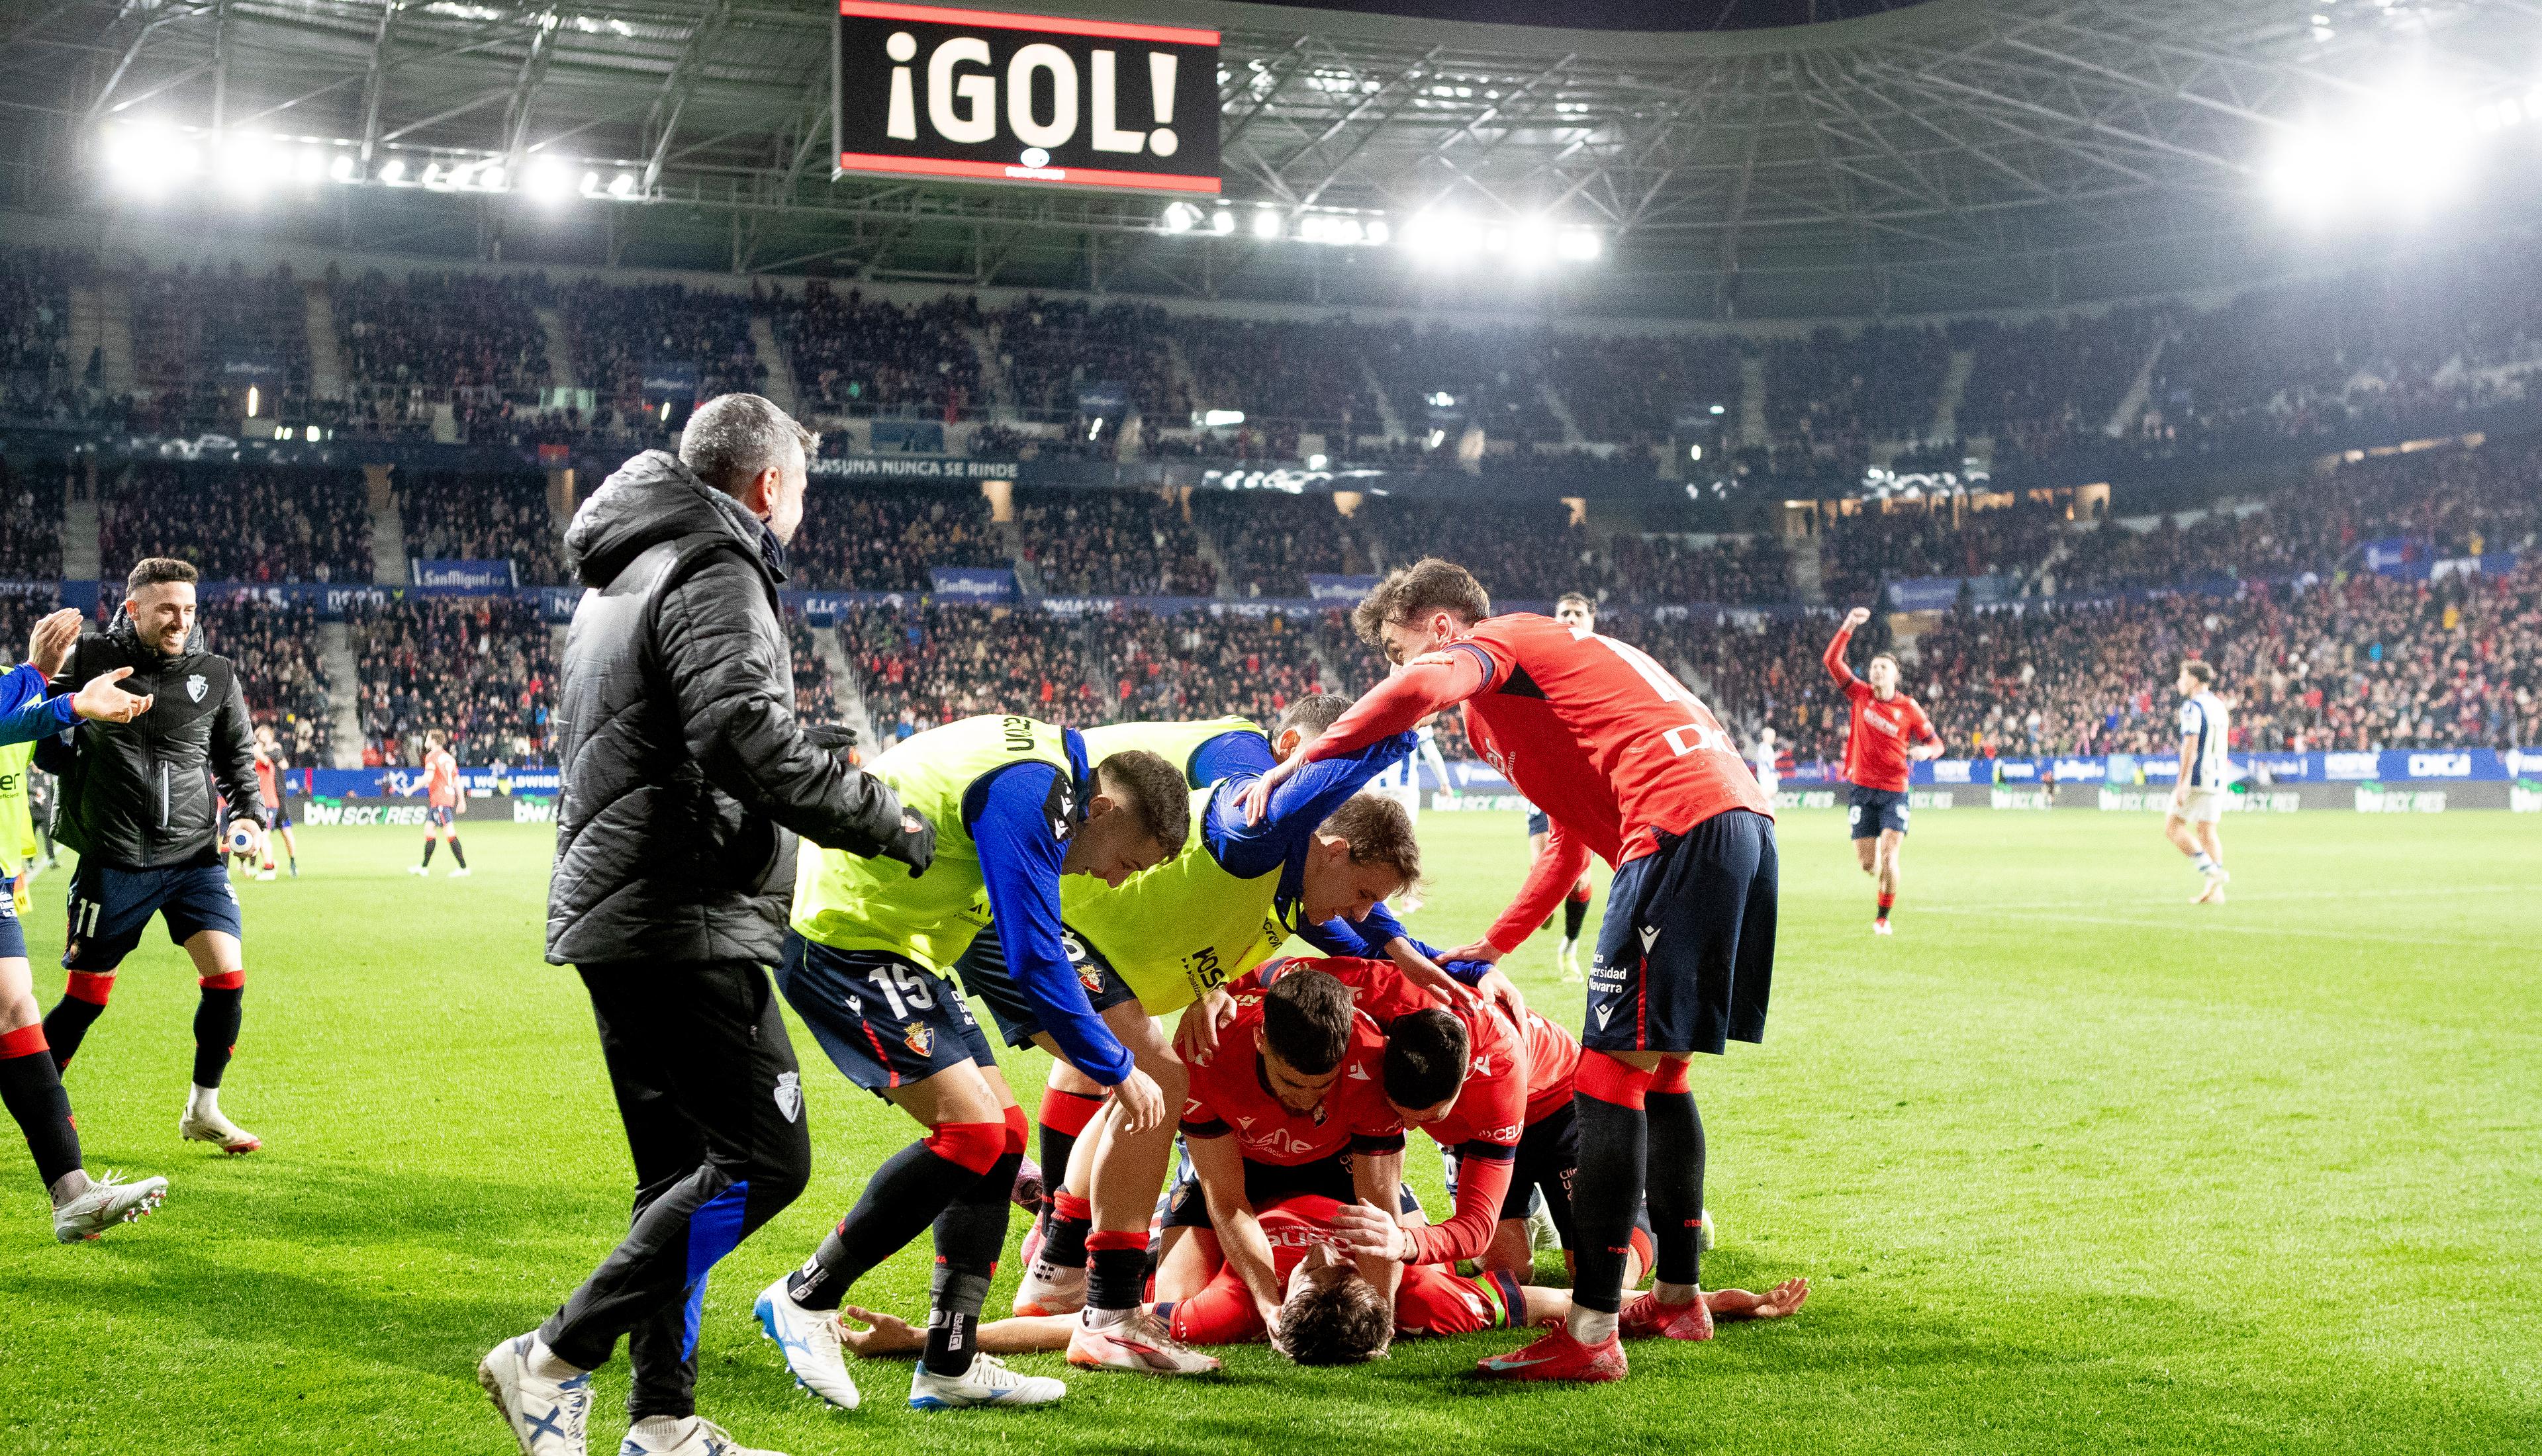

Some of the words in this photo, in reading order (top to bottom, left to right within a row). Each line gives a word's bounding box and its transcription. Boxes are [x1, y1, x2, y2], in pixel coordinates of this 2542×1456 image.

[886, 31, 1179, 158] ¡GOL!
[882, 461, 941, 476] NUNCA
[945, 462, 964, 477] SE
[967, 463, 1018, 478] RINDE
[71, 897, 101, 938] 11
[869, 962, 933, 1020] 15
